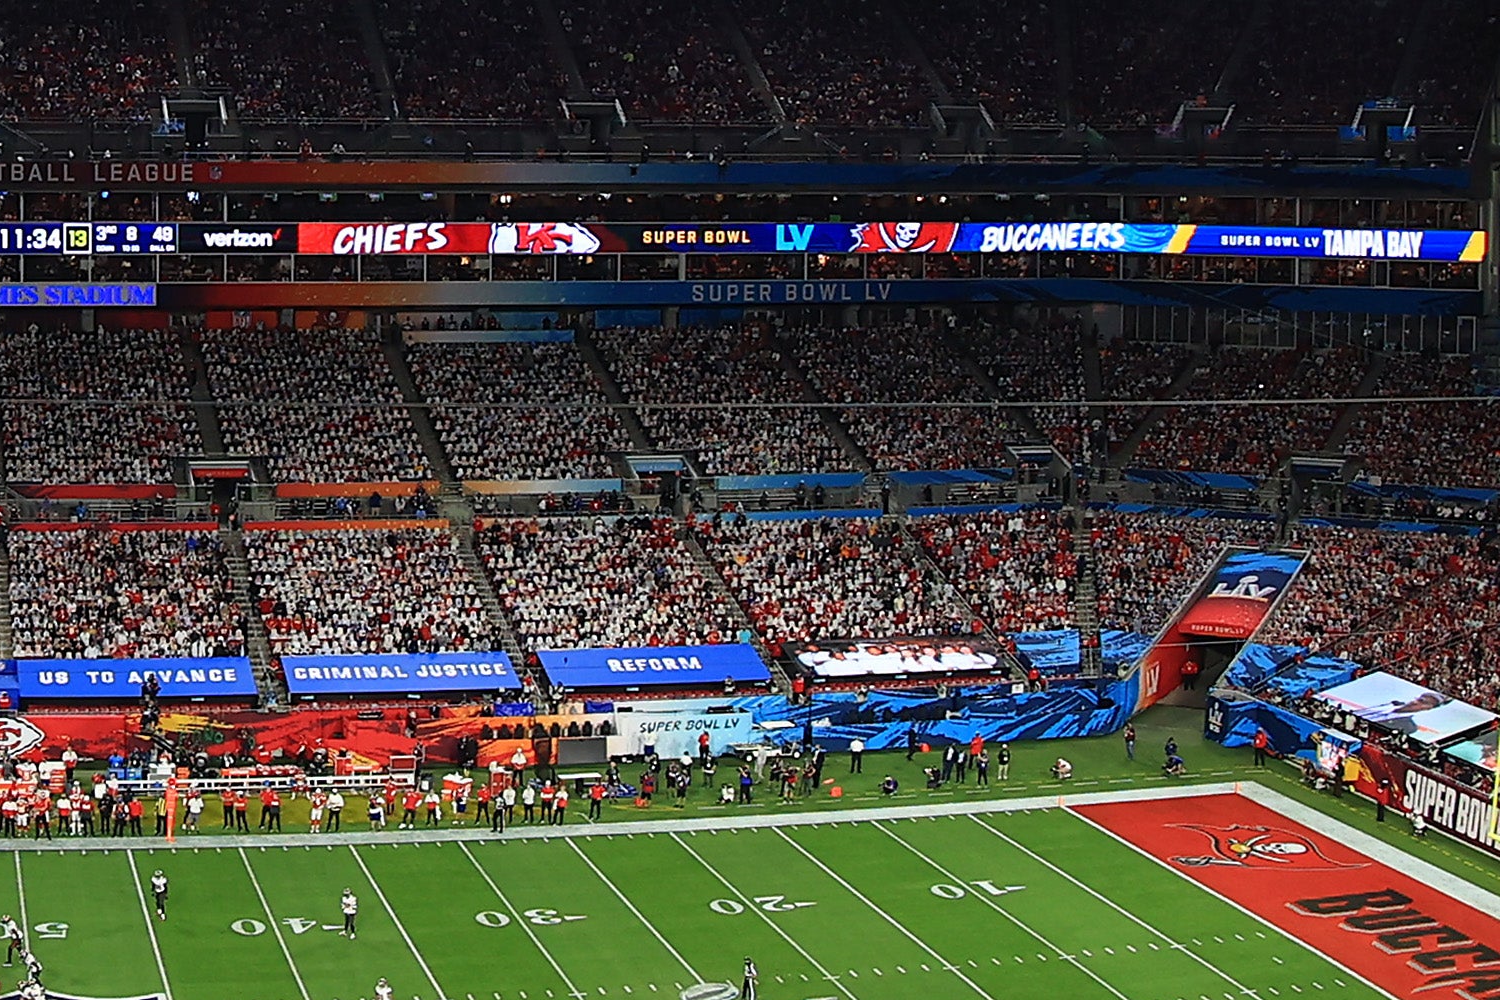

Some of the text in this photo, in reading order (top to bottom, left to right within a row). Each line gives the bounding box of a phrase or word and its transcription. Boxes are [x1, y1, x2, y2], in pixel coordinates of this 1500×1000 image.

[94, 163, 195, 182] LEAGUE
[0, 228, 62, 250] 11:34
[68, 229, 88, 248] 13
[125, 226, 138, 242] 8
[152, 226, 174, 242] 49
[202, 228, 273, 248] verizon
[332, 222, 449, 254] CHIEFS
[641, 223, 816, 251] SUPER BOWL LV
[979, 222, 1126, 253] BUCCANEERS
[1220, 229, 1424, 259] SUPER BOWL LV TAMPA BAY
[45, 284, 157, 306] STADIUM
[691, 282, 891, 301] SUPER BOWL LV
[293, 661, 508, 681] CRIMINAL JUSTICE
[605, 655, 703, 673] REFORM
[38, 668, 238, 685] US TO ADVANCE
[1145, 660, 1160, 697] LV
[639, 717, 740, 734] SUPER BOWL LV
[1403, 769, 1458, 830] SUPER
[929, 879, 1009, 900] 10
[708, 895, 795, 916] 20
[230, 917, 318, 937] 40
[474, 908, 564, 928] 30
